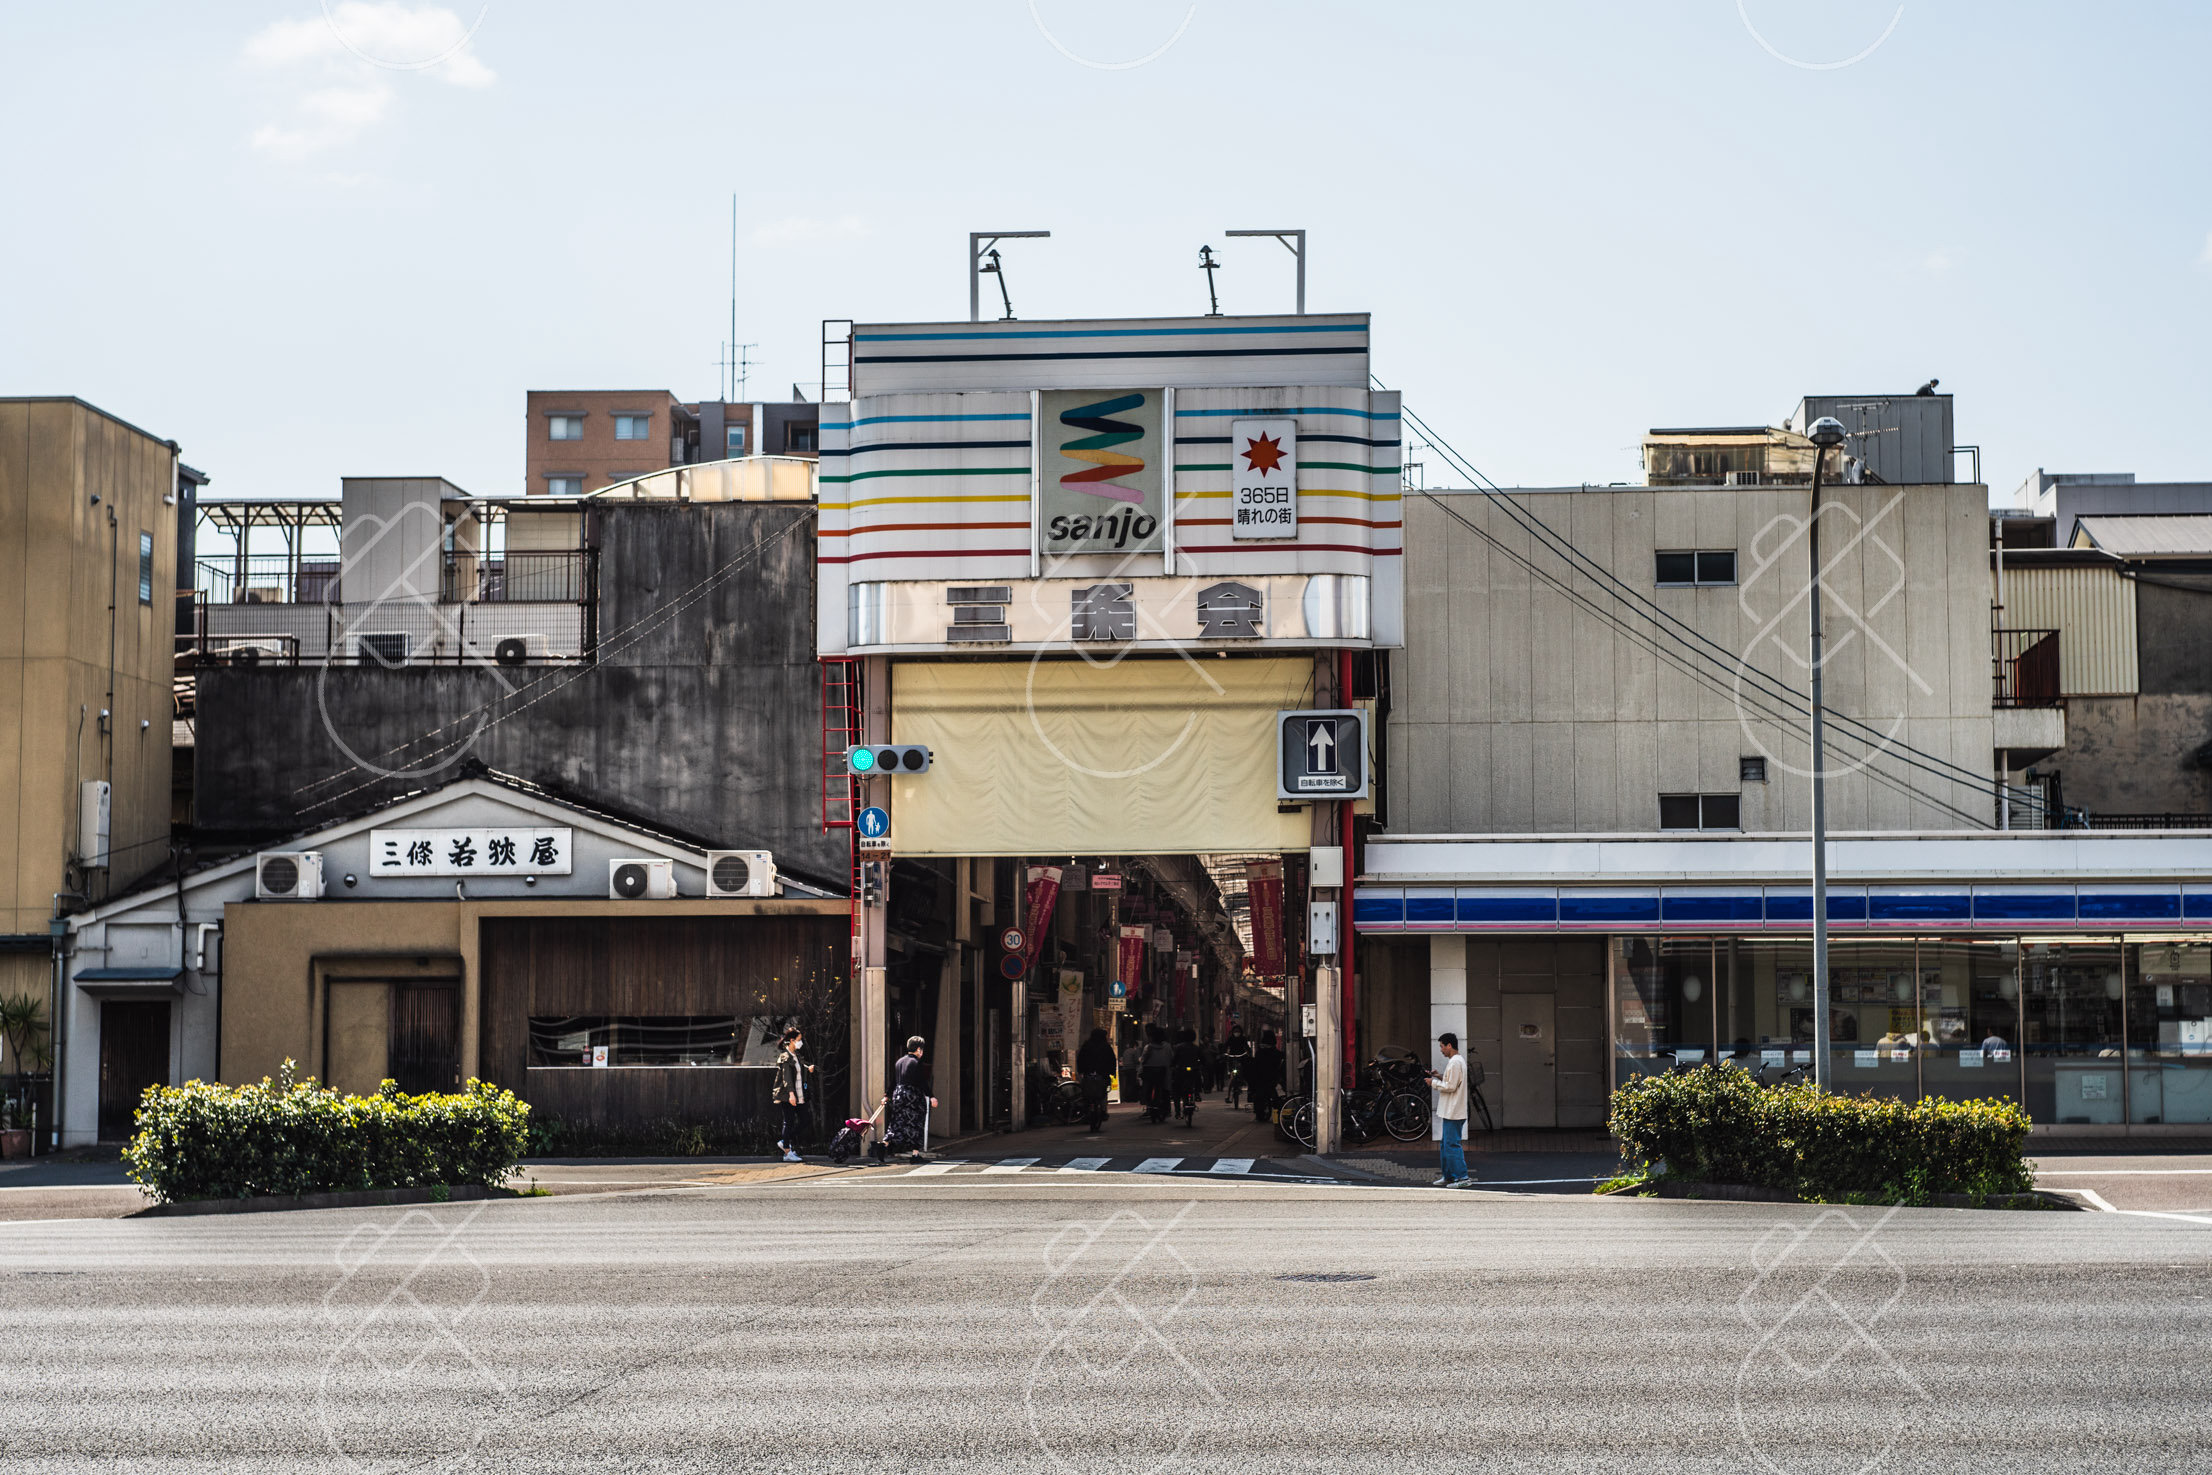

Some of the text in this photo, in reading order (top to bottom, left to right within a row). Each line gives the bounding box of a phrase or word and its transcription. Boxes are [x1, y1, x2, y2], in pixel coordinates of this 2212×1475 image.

[1240, 487, 1289, 504] 365日
[1237, 507, 1292, 525] 晴れの街
[1047, 507, 1157, 549] sanjo
[946, 581, 1263, 642] 三条会
[1300, 778, 1344, 787] 自転車を除く
[1006, 934, 1021, 946] 30
